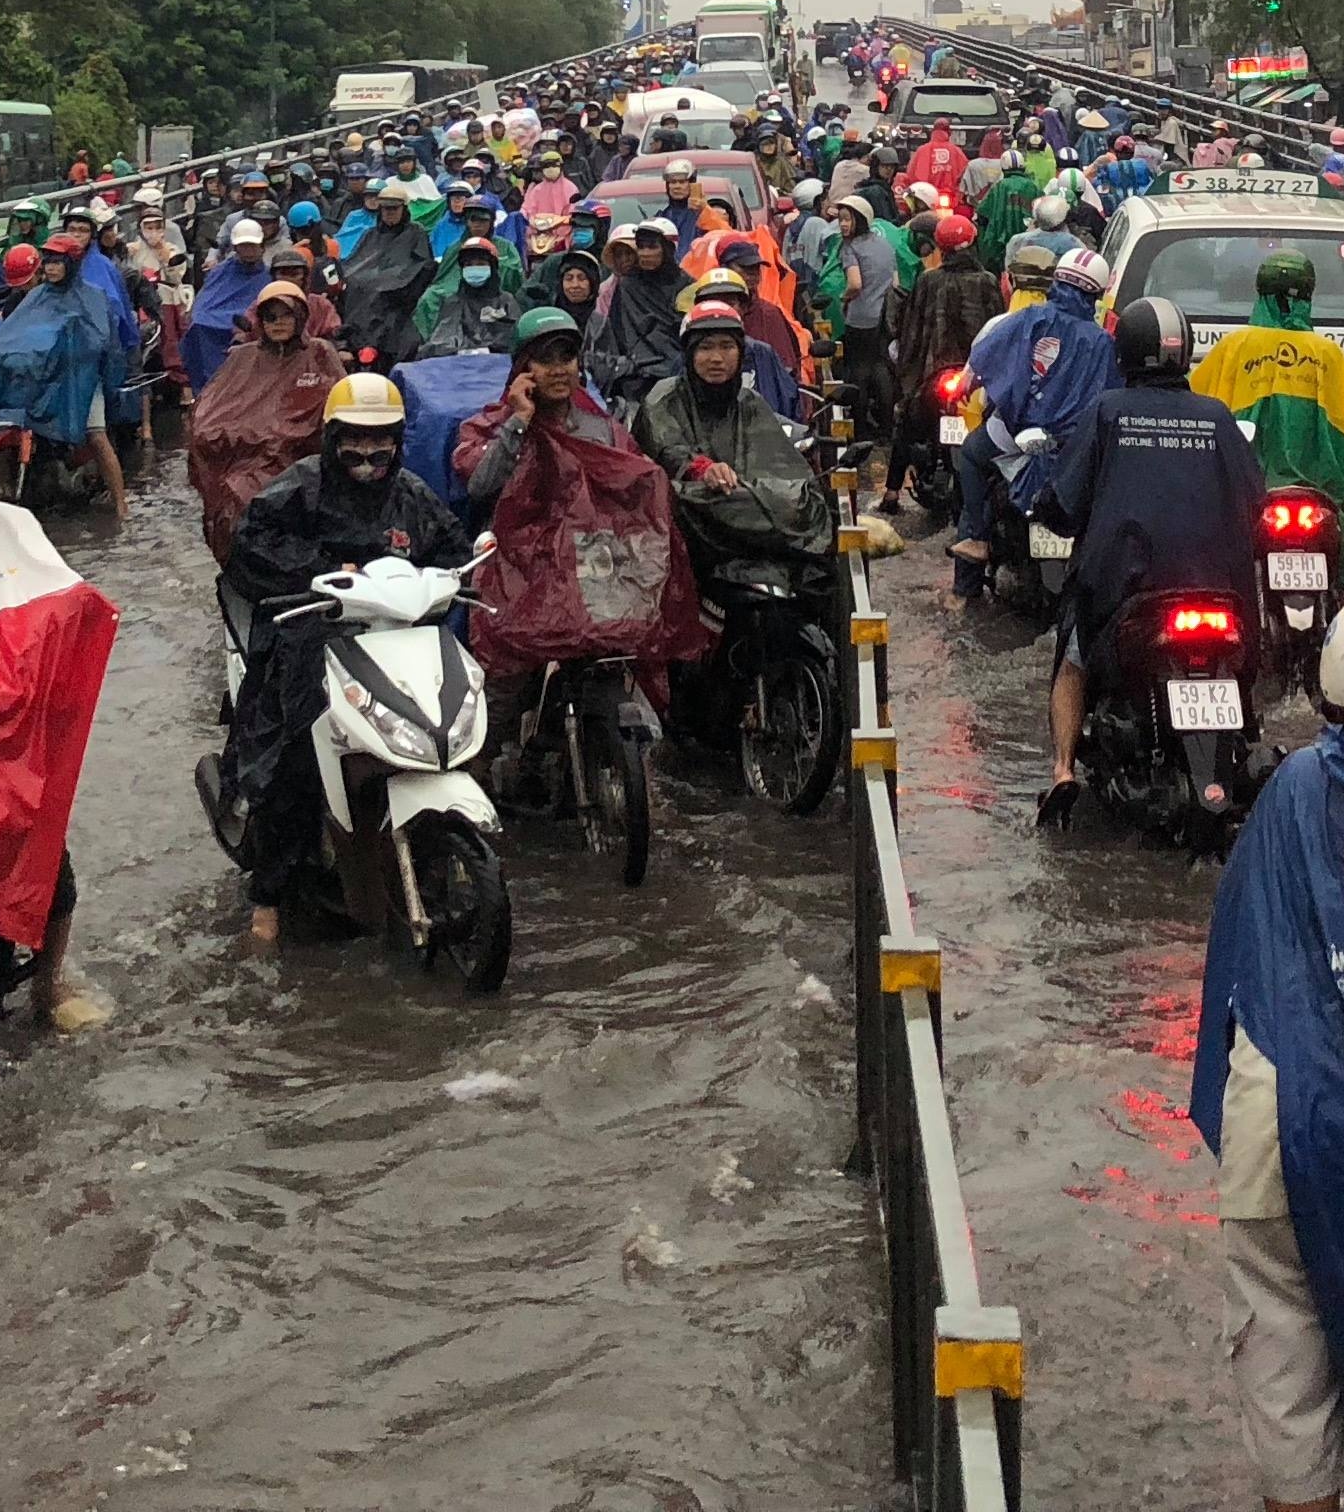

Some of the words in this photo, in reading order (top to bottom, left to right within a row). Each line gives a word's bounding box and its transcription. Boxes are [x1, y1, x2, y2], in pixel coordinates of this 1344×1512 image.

[1263, 178, 1286, 193] 27
[1291, 180, 1315, 193] 27
[1157, 418, 1179, 428] HEAD
[943, 431, 964, 442] 389
[1158, 437, 1180, 448] 1800
[1181, 437, 1193, 449] 54
[1277, 556, 1316, 571] 59-H1
[1274, 572, 1324, 589] 495.50
[1178, 684, 1230, 704] 59-K2
[1175, 706, 1238, 727] 194.60
